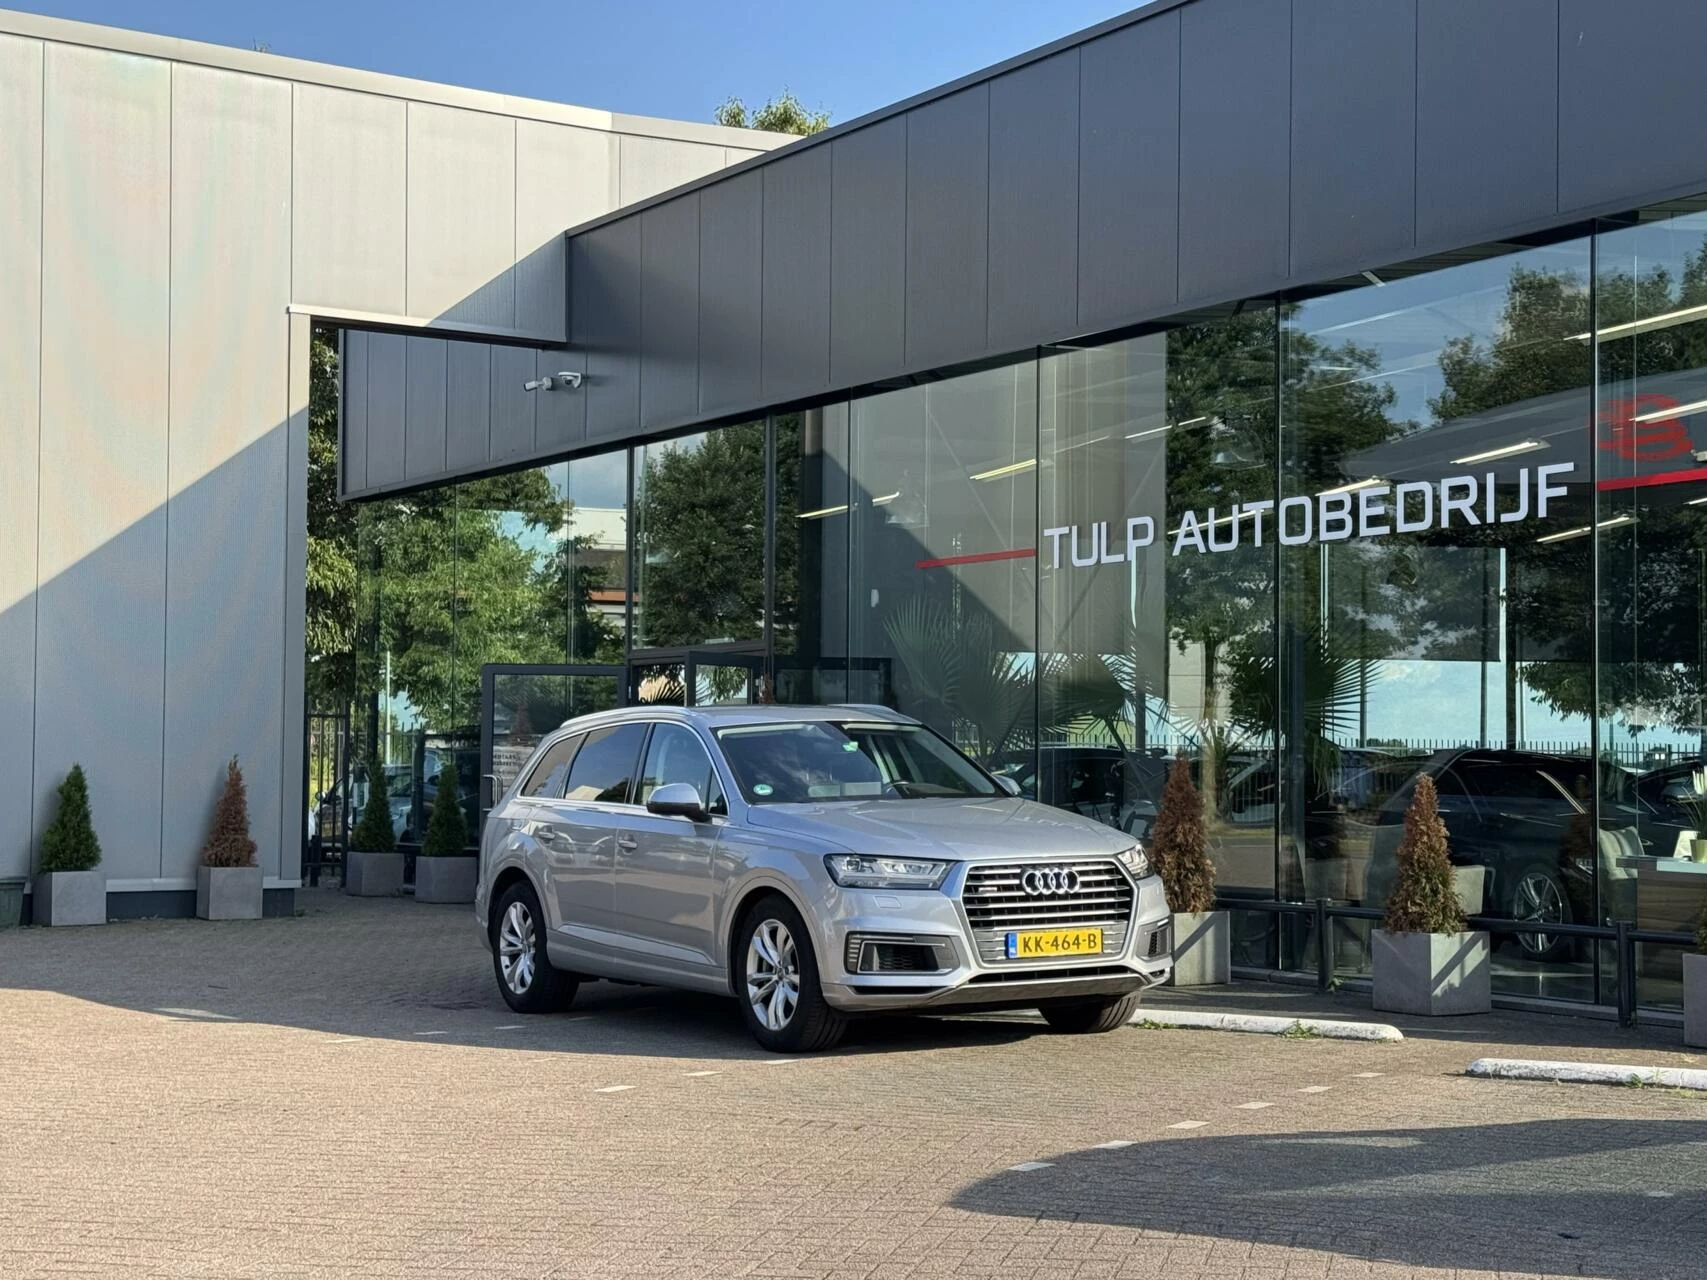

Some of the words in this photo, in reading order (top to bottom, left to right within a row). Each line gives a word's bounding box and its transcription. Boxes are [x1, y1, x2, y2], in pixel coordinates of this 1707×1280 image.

[1044, 515, 1155, 569] TULP
[1172, 462, 1575, 557] AUTOBEDRIJF
[1023, 933, 1097, 953] KK-464-B
